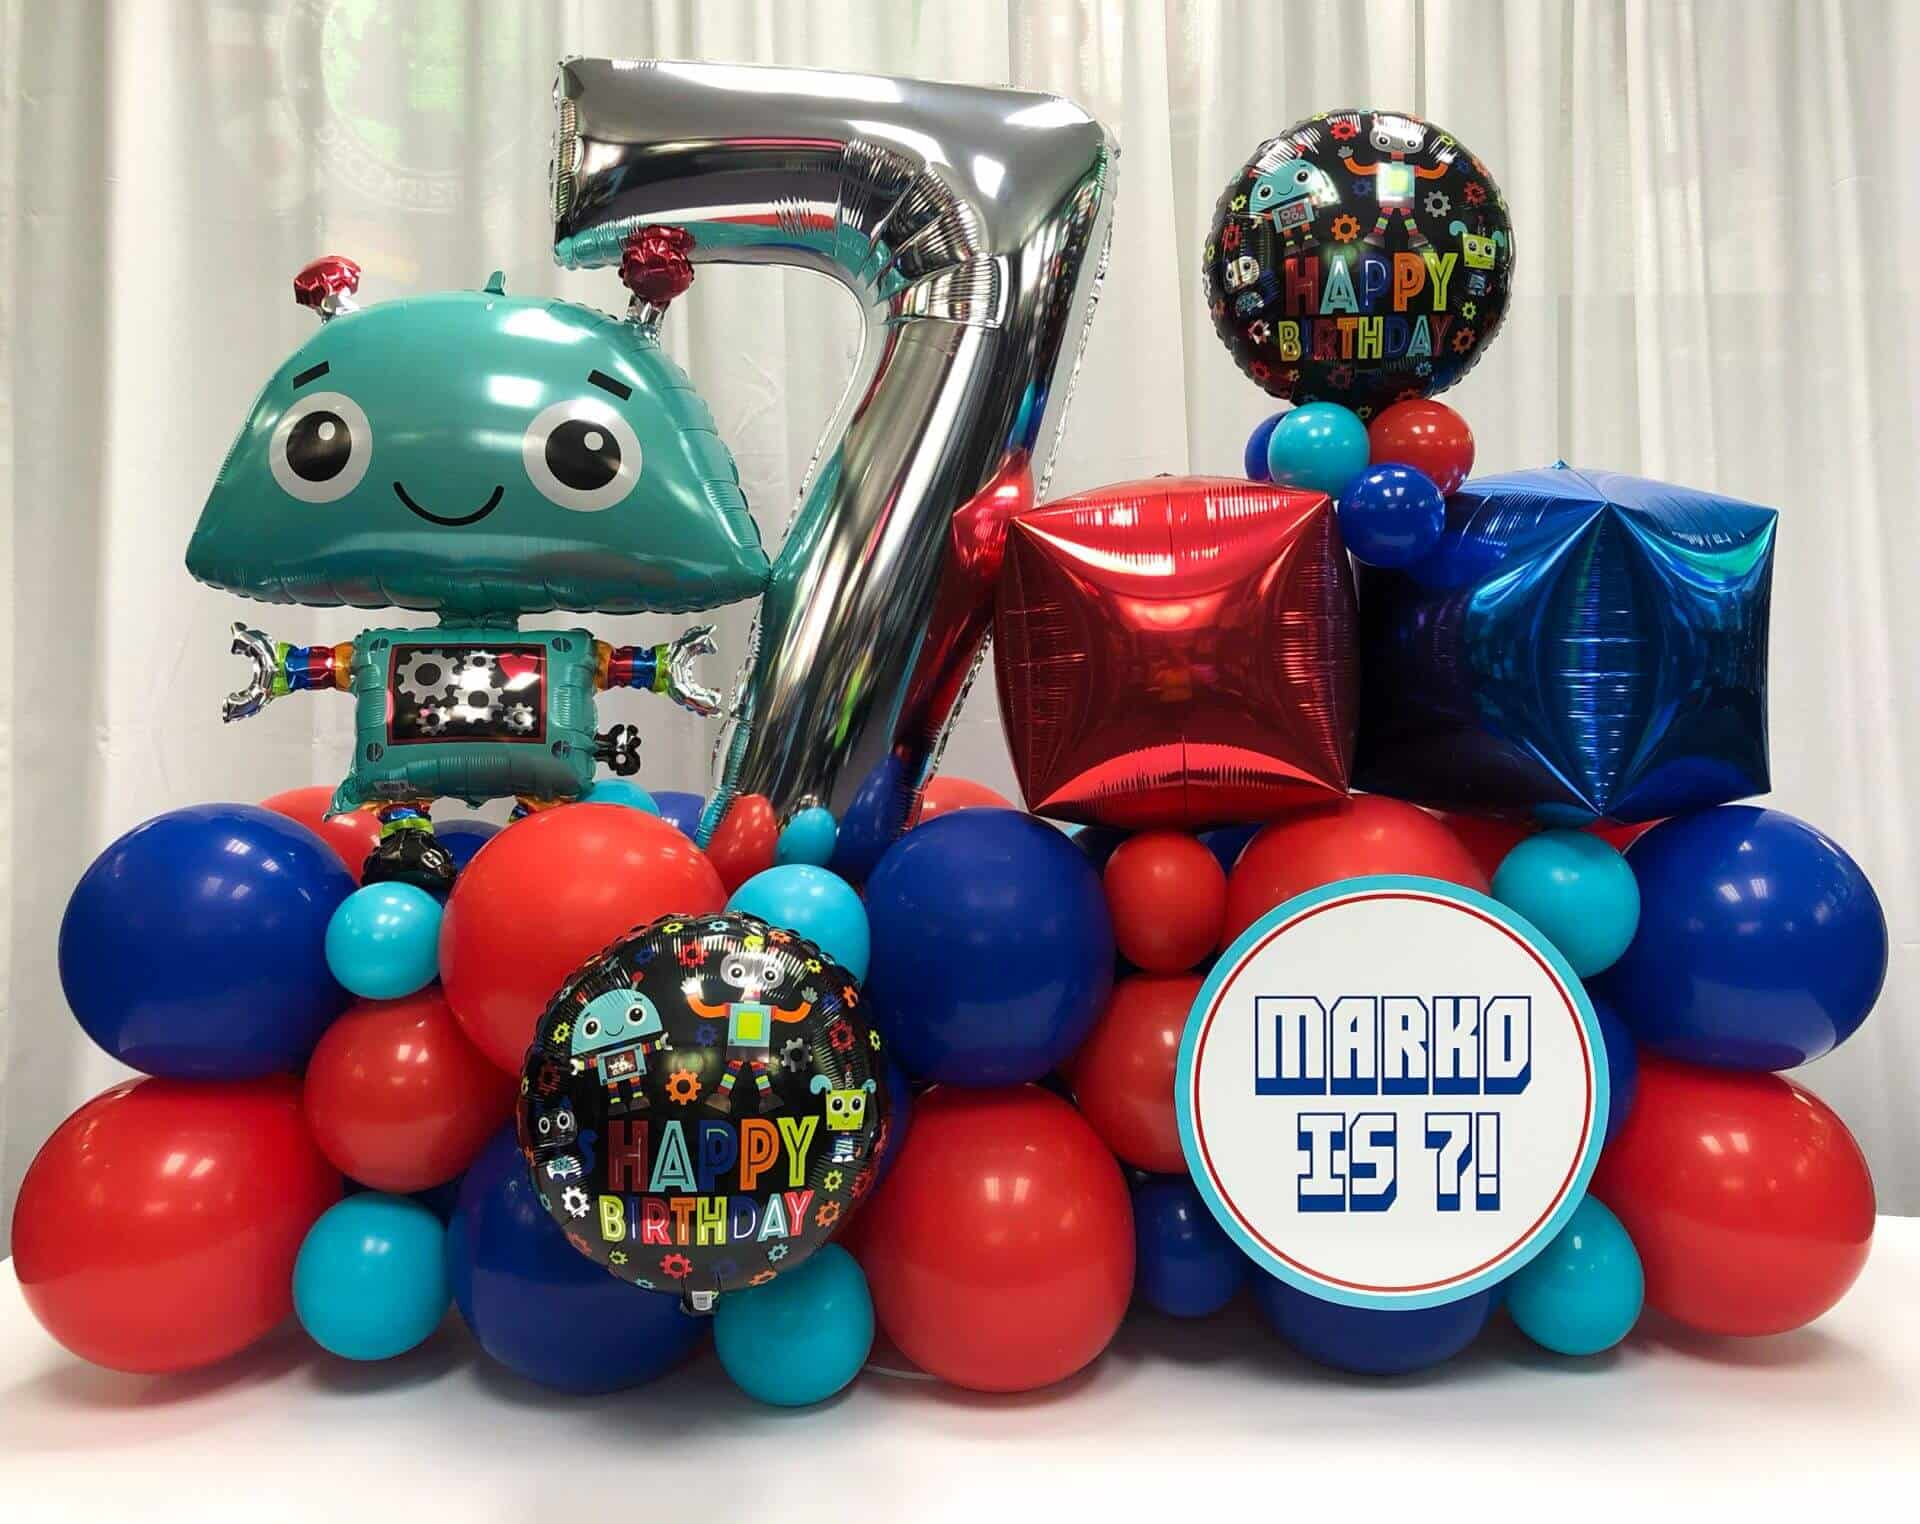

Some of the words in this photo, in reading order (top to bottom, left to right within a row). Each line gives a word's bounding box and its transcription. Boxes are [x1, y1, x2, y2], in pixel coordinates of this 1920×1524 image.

[1284, 252, 1458, 316] HAPPY
[1277, 315, 1455, 362] BIRTHDAY
[552, 55, 1118, 856] 7
[1254, 995, 1532, 1096] MARKO
[607, 1115, 819, 1192] HAPPY
[1297, 1112, 1397, 1213] IS
[1424, 1111, 1501, 1212] 7!
[598, 1190, 815, 1246] BIRTHDAY
